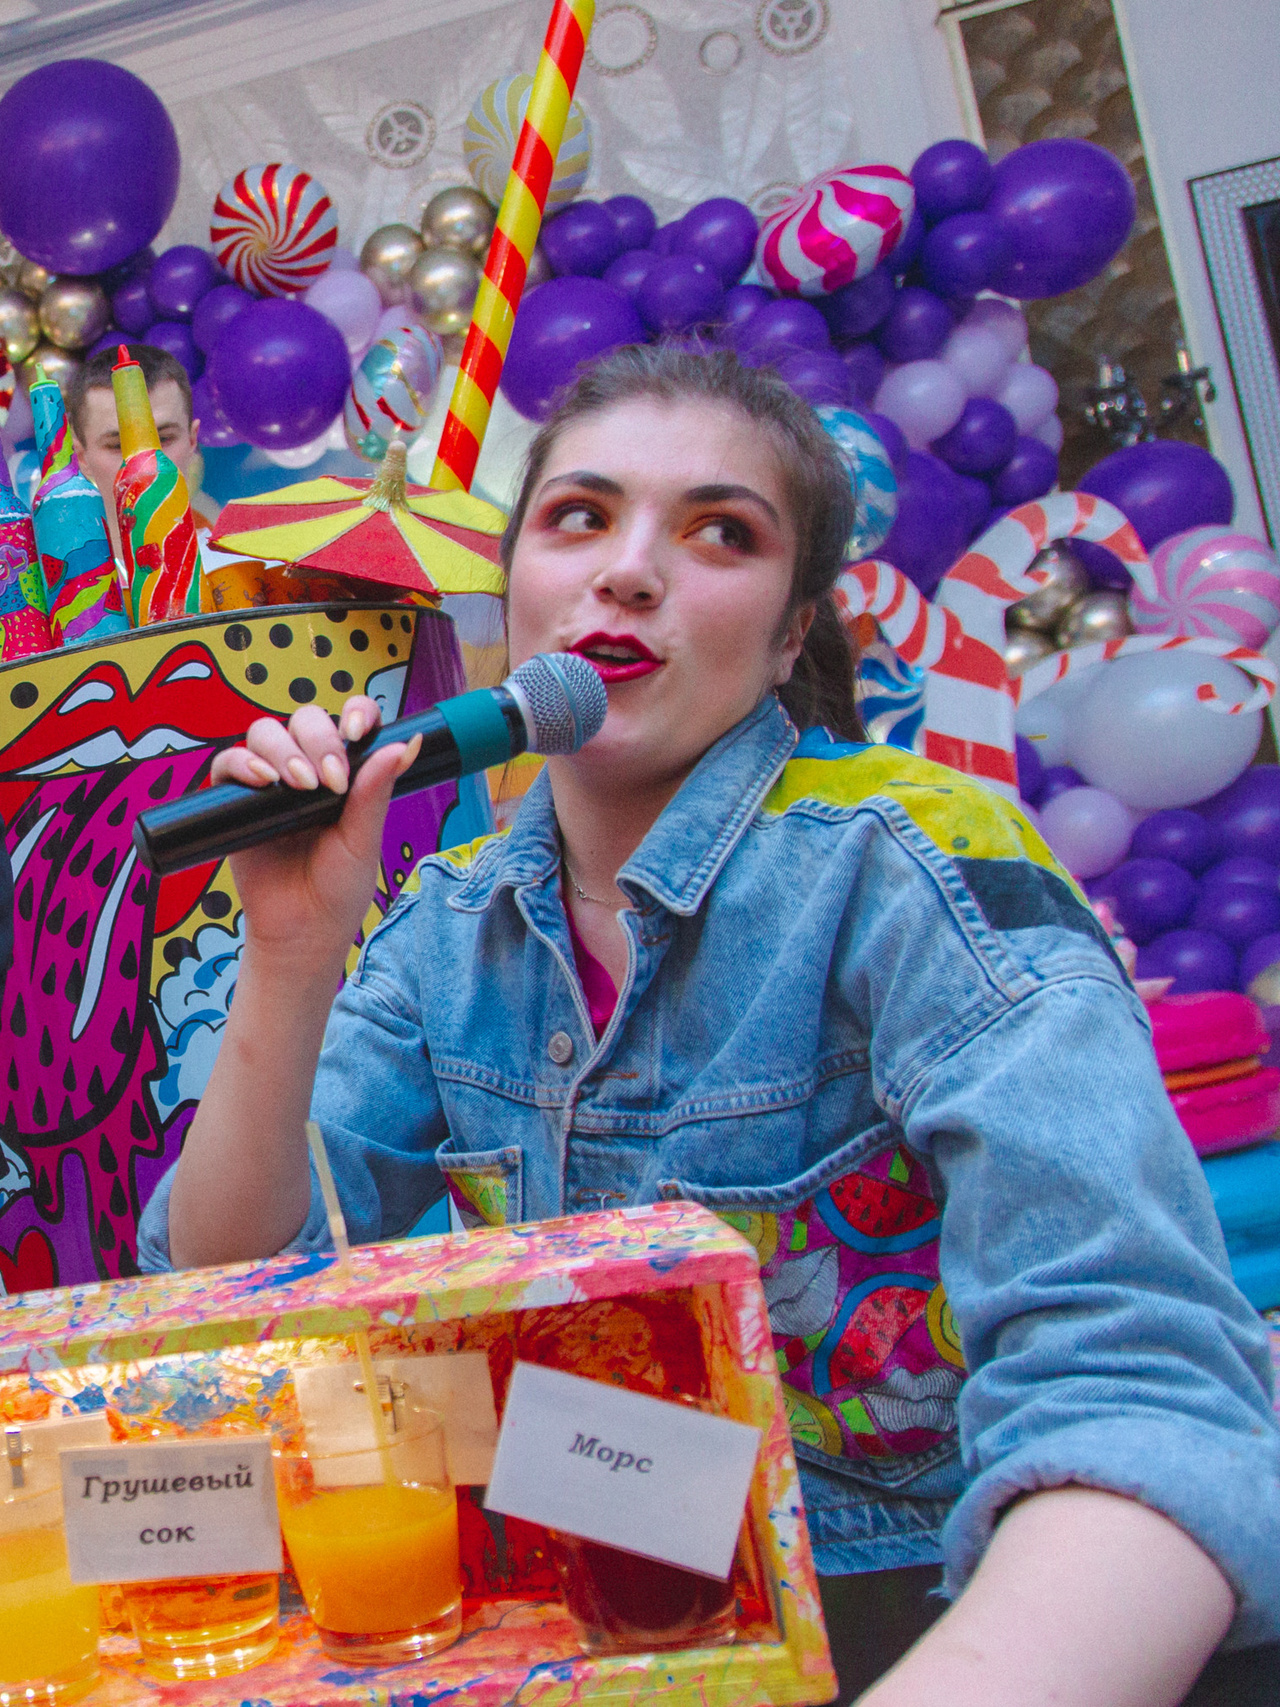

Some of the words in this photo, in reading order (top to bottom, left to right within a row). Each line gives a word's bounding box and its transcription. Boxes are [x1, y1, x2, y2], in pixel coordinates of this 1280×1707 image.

[568, 1432, 653, 1473] Морс
[82, 1464, 254, 1503] Грушевый
[139, 1525, 195, 1545] сок
